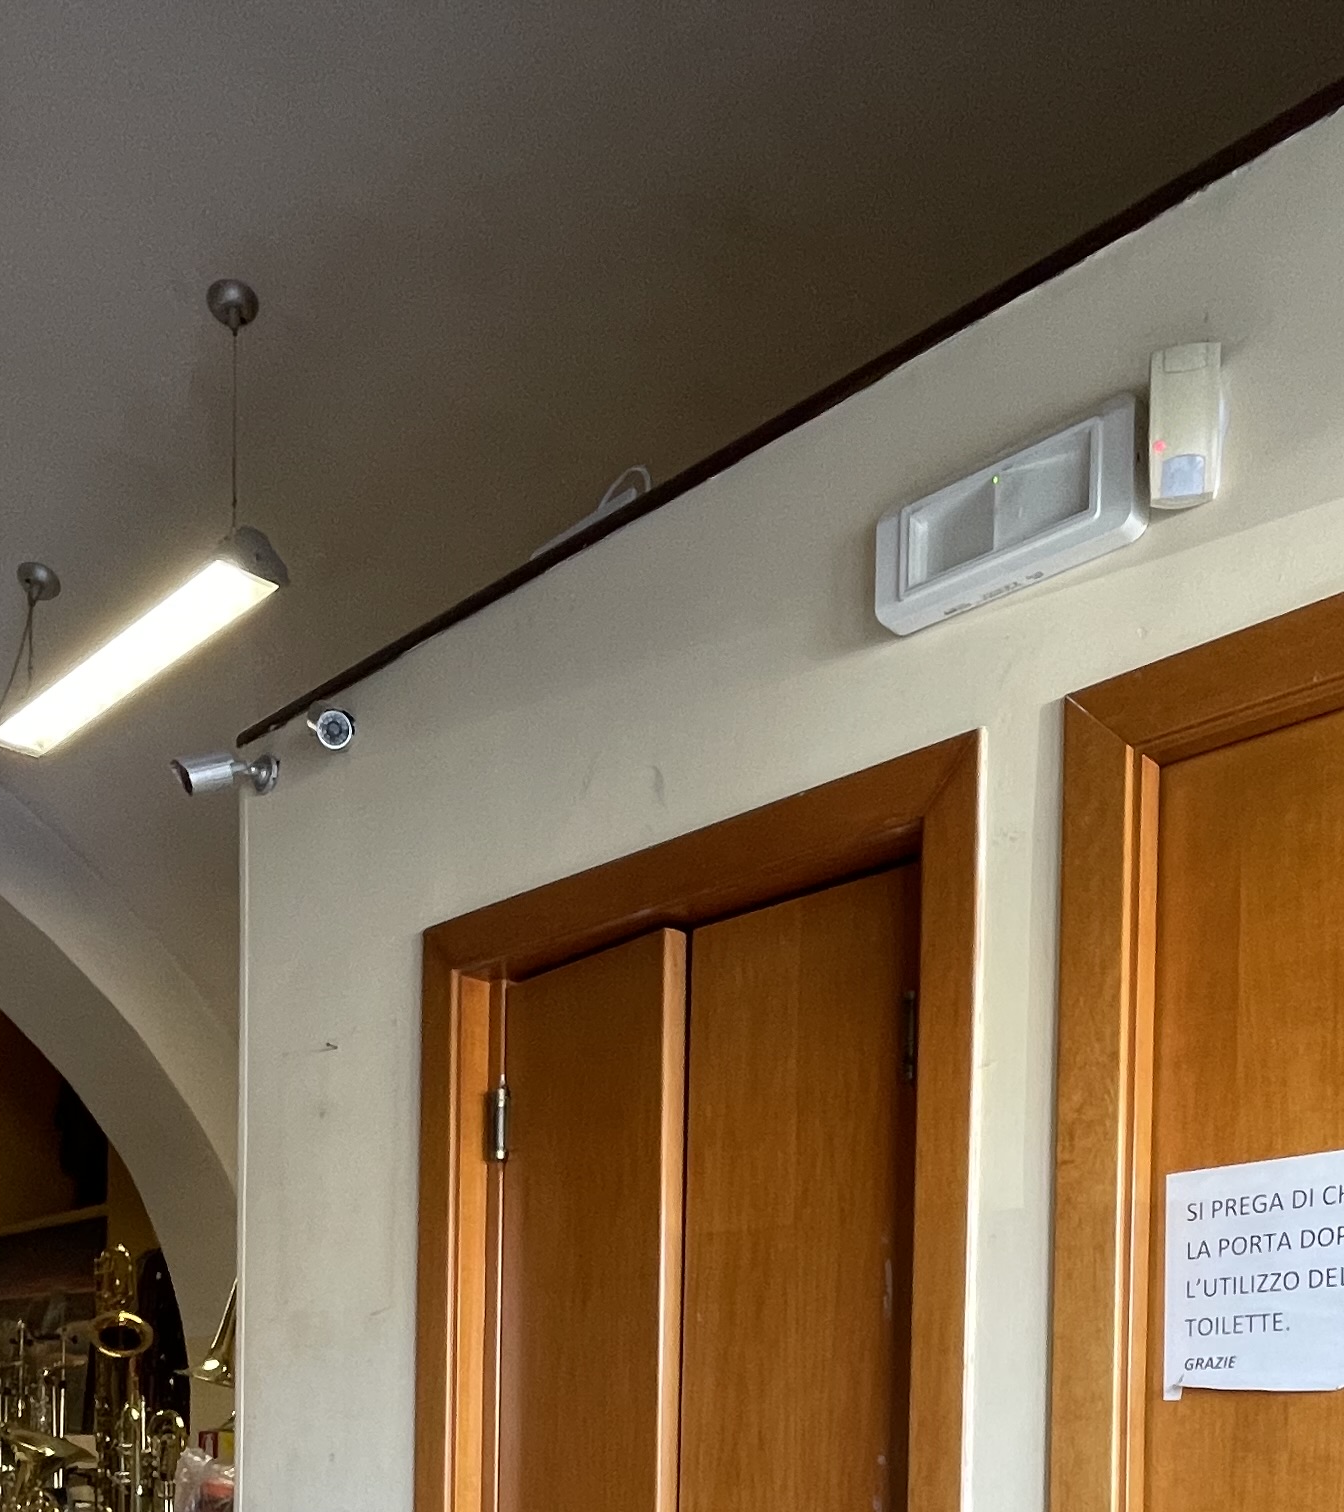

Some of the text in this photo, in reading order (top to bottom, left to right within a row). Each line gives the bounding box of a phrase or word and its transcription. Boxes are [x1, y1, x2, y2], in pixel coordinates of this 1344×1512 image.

[1187, 1201, 1203, 1222] SI
[1212, 1193, 1283, 1217] PREGA
[1292, 1189, 1314, 1209] DI
[1187, 1240, 1210, 1260] LA
[1219, 1232, 1291, 1257] PORTA
[1185, 1312, 1290, 1337] TOILETTE.
[1184, 1356, 1237, 1371] GRAZIE
